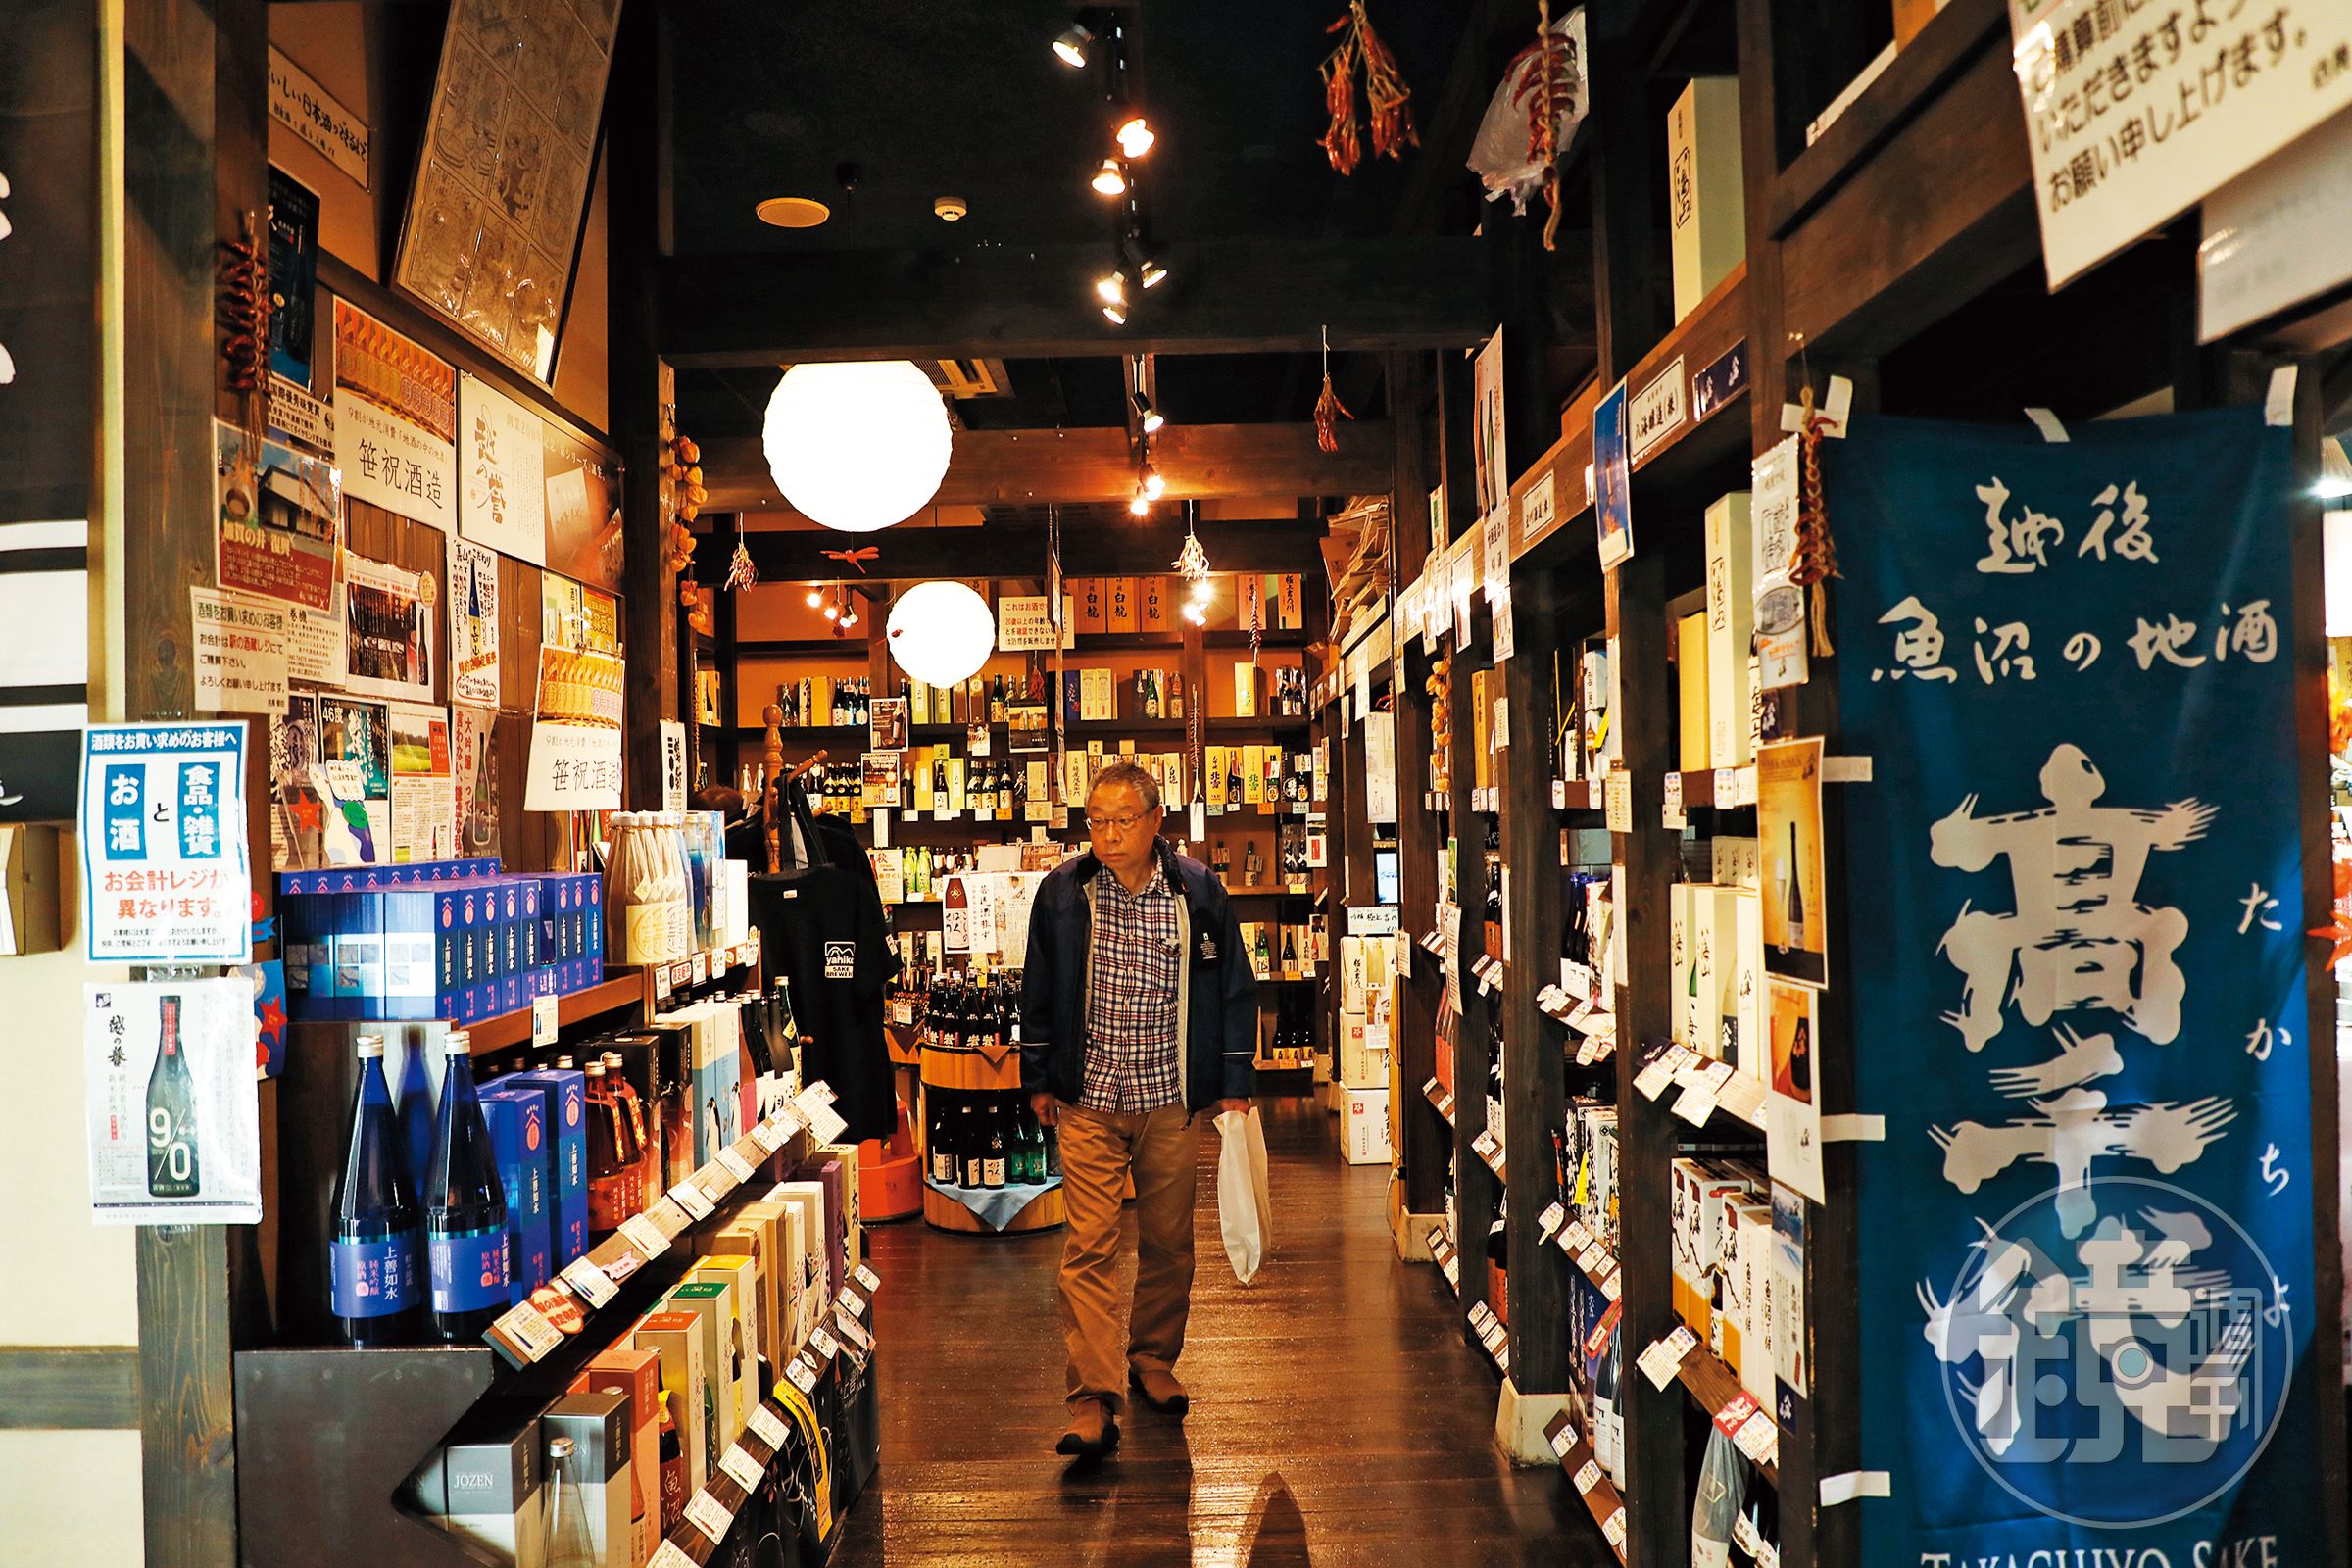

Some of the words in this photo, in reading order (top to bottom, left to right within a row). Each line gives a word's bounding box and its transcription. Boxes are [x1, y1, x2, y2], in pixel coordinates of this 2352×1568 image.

[2048, 7, 2307, 213] お願い申し上げます。
[358, 438, 443, 509] 笹祝酒造
[1975, 476, 2159, 574] 越後
[198, 602, 284, 631] 酒類をお買い求めのお客様
[289, 608, 308, 624] 巻機
[1114, 592, 1128, 619] 白龍
[199, 633, 284, 655] お会計は駅の酒蔵レジにて
[1871, 595, 2278, 685] 魚沼の地酒
[200, 676, 285, 694] よろしくお願い申し上げます。
[322, 707, 344, 724] 46度
[91, 731, 237, 752] 酒類をお買い求めのお客様へ
[109, 773, 141, 853] お酒
[153, 802, 170, 822] と
[183, 764, 216, 856] 食品・雑貨
[877, 853, 889, 863] 秋
[104, 869, 228, 893] お会計レジが
[117, 897, 221, 919] 異なります。
[1916, 743, 2254, 1456] 高千代
[2237, 881, 2292, 1328] たかちよ
[384, 1246, 399, 1301] 上善如水
[454, 1474, 494, 1489] JOZEN
